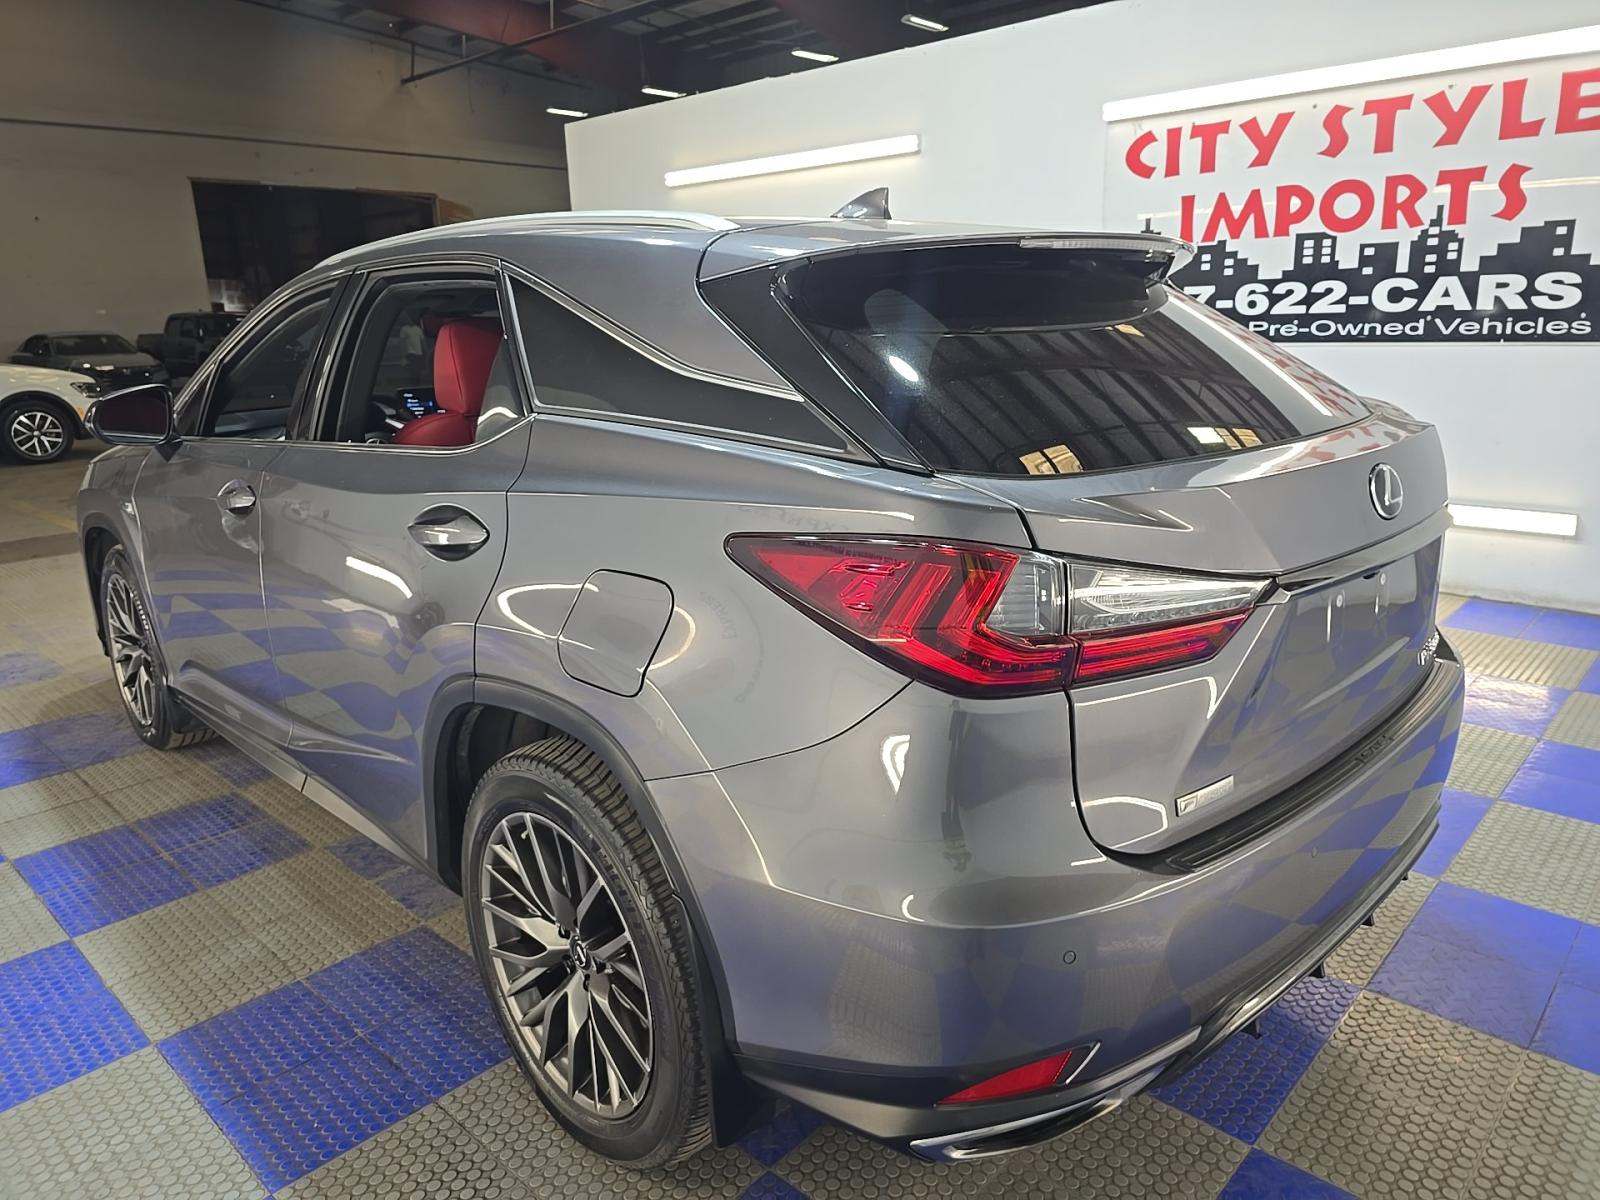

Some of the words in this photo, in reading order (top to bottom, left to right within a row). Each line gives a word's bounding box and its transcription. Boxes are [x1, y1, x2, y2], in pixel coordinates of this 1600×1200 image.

[1125, 111, 1295, 179] CITY
[1317, 68, 1600, 158] STYLE
[1180, 163, 1533, 243] IMPORTS
[1434, 317, 1591, 335] Vehicles
